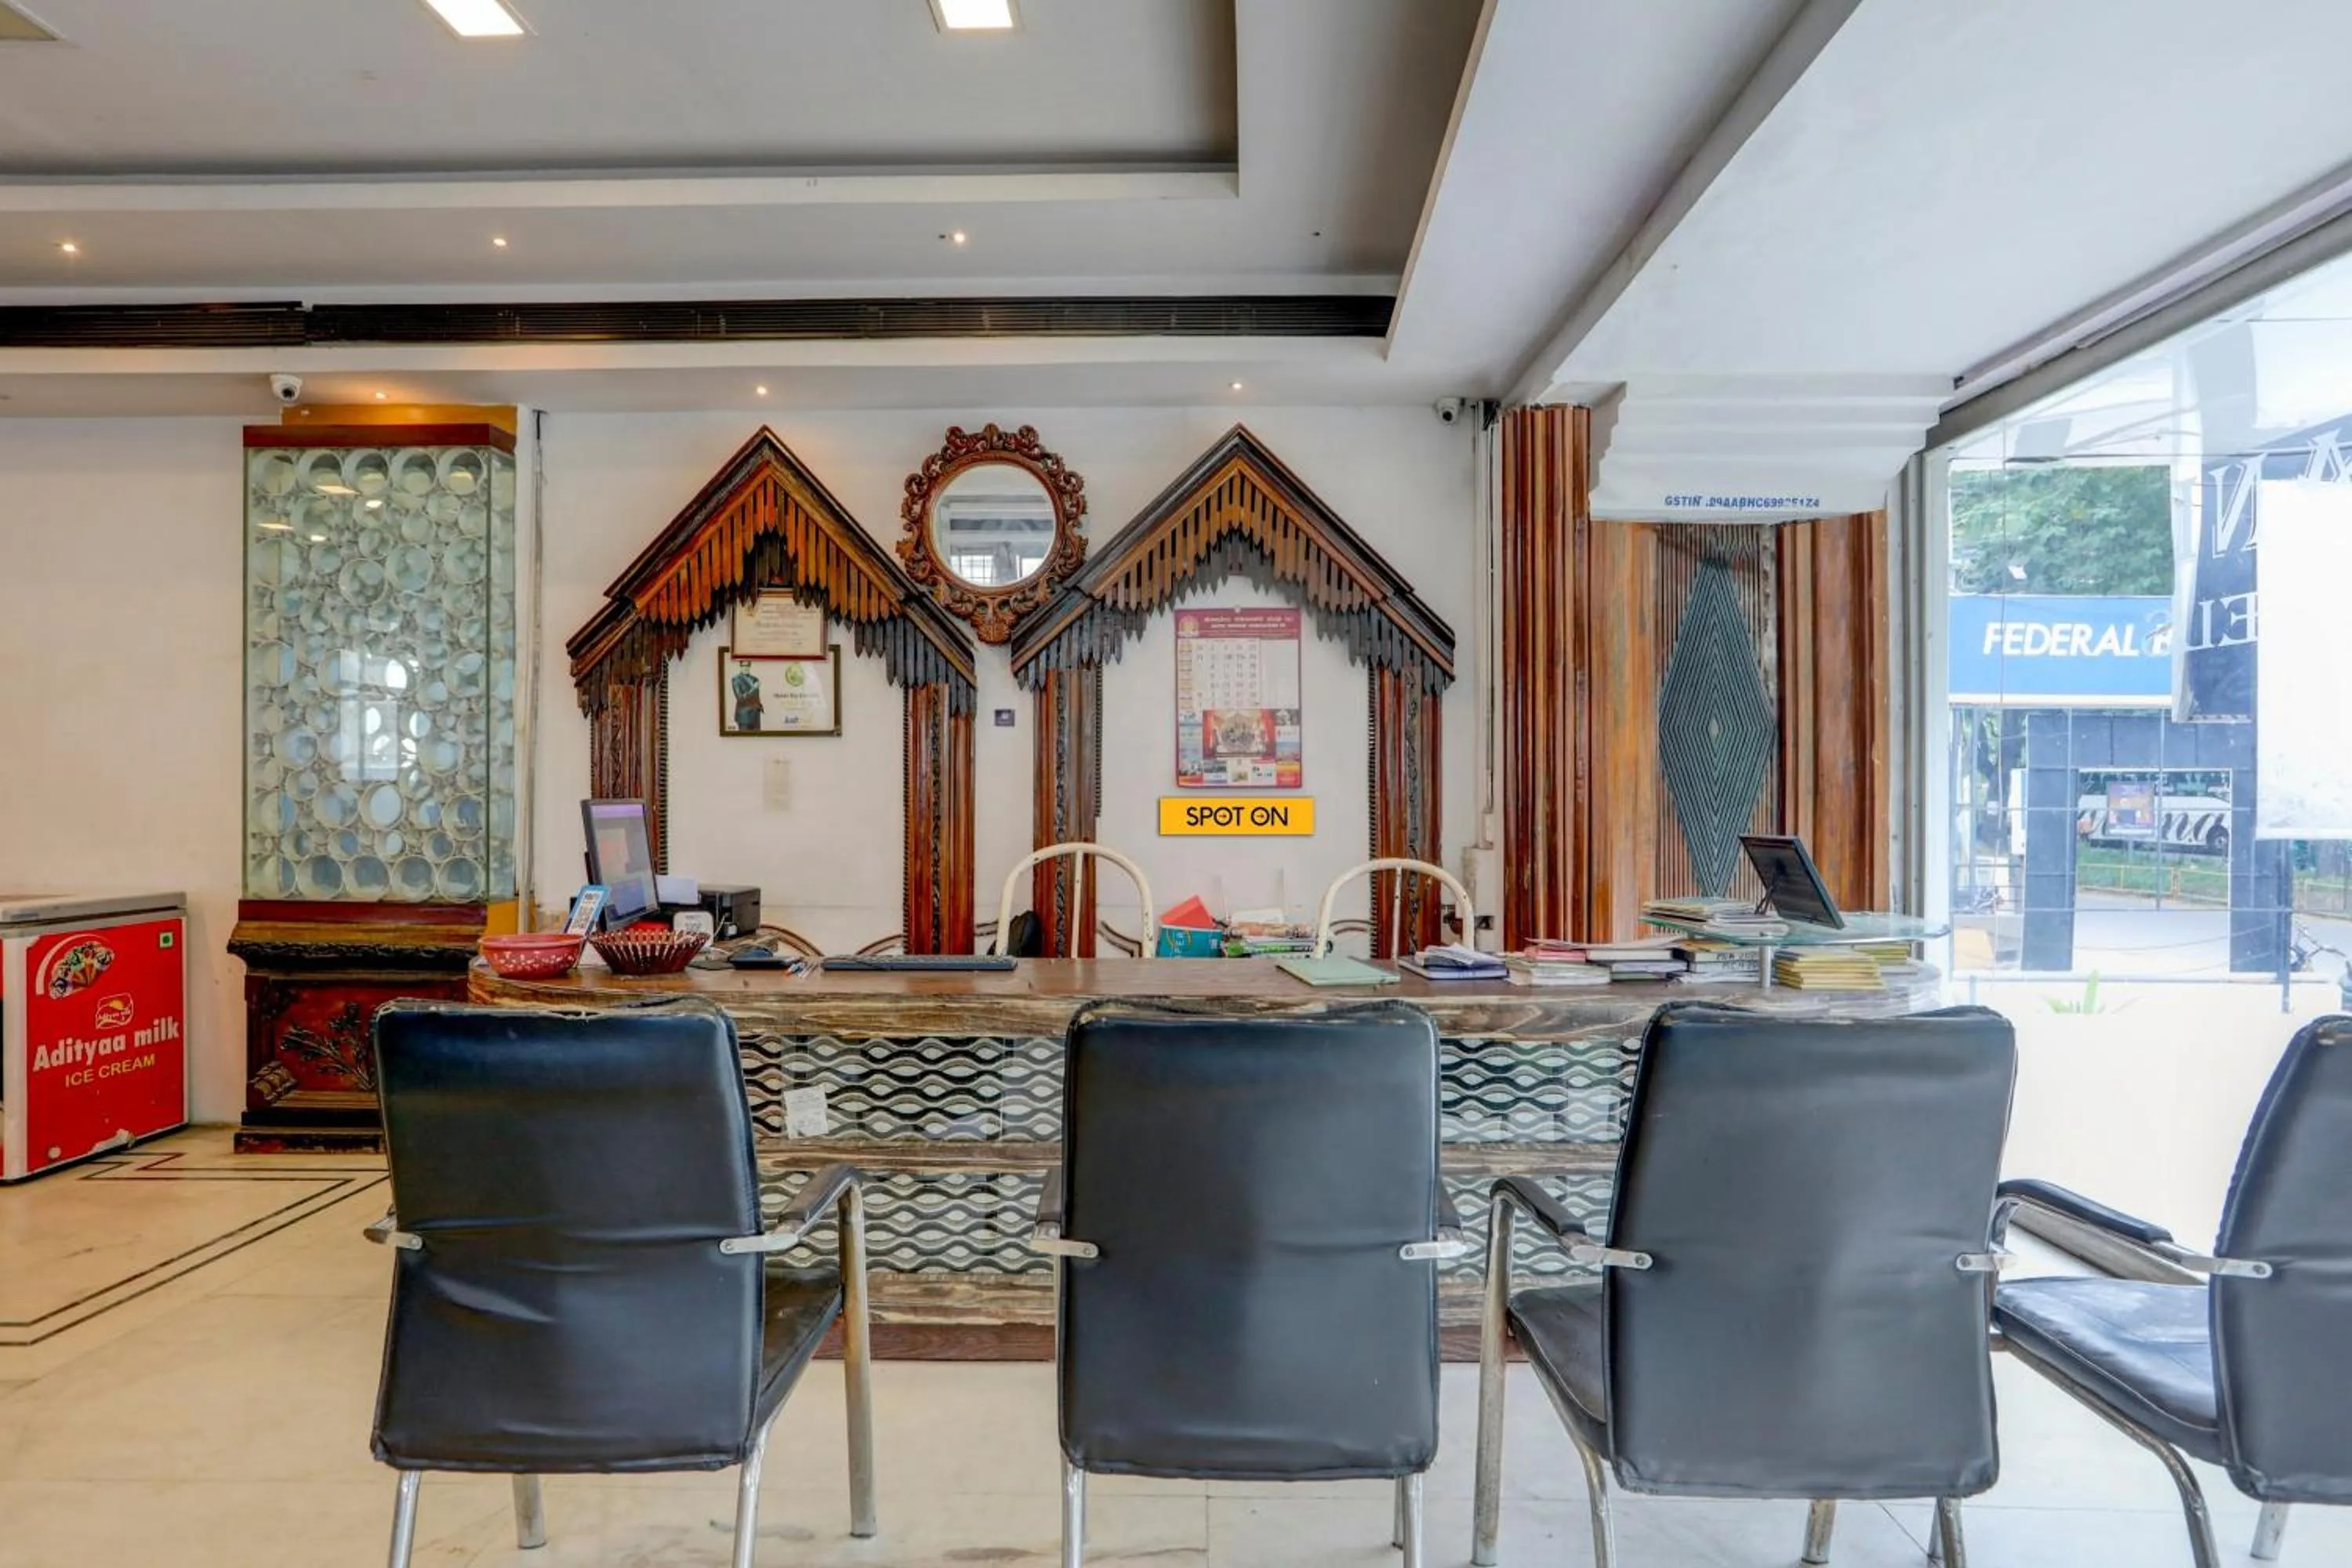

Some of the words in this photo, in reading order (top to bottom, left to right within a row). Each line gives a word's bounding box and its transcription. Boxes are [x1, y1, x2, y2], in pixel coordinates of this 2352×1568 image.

[1664, 495, 1702, 507] GSTIN
[1982, 622, 2140, 657] FEDERAL
[1186, 807, 1244, 826] SPOT
[1250, 806, 1288, 826] ON
[33, 1035, 125, 1072] Adityaa
[134, 1016, 179, 1047] milk
[65, 1069, 93, 1088] ICE
[99, 1054, 155, 1078] CREAM
